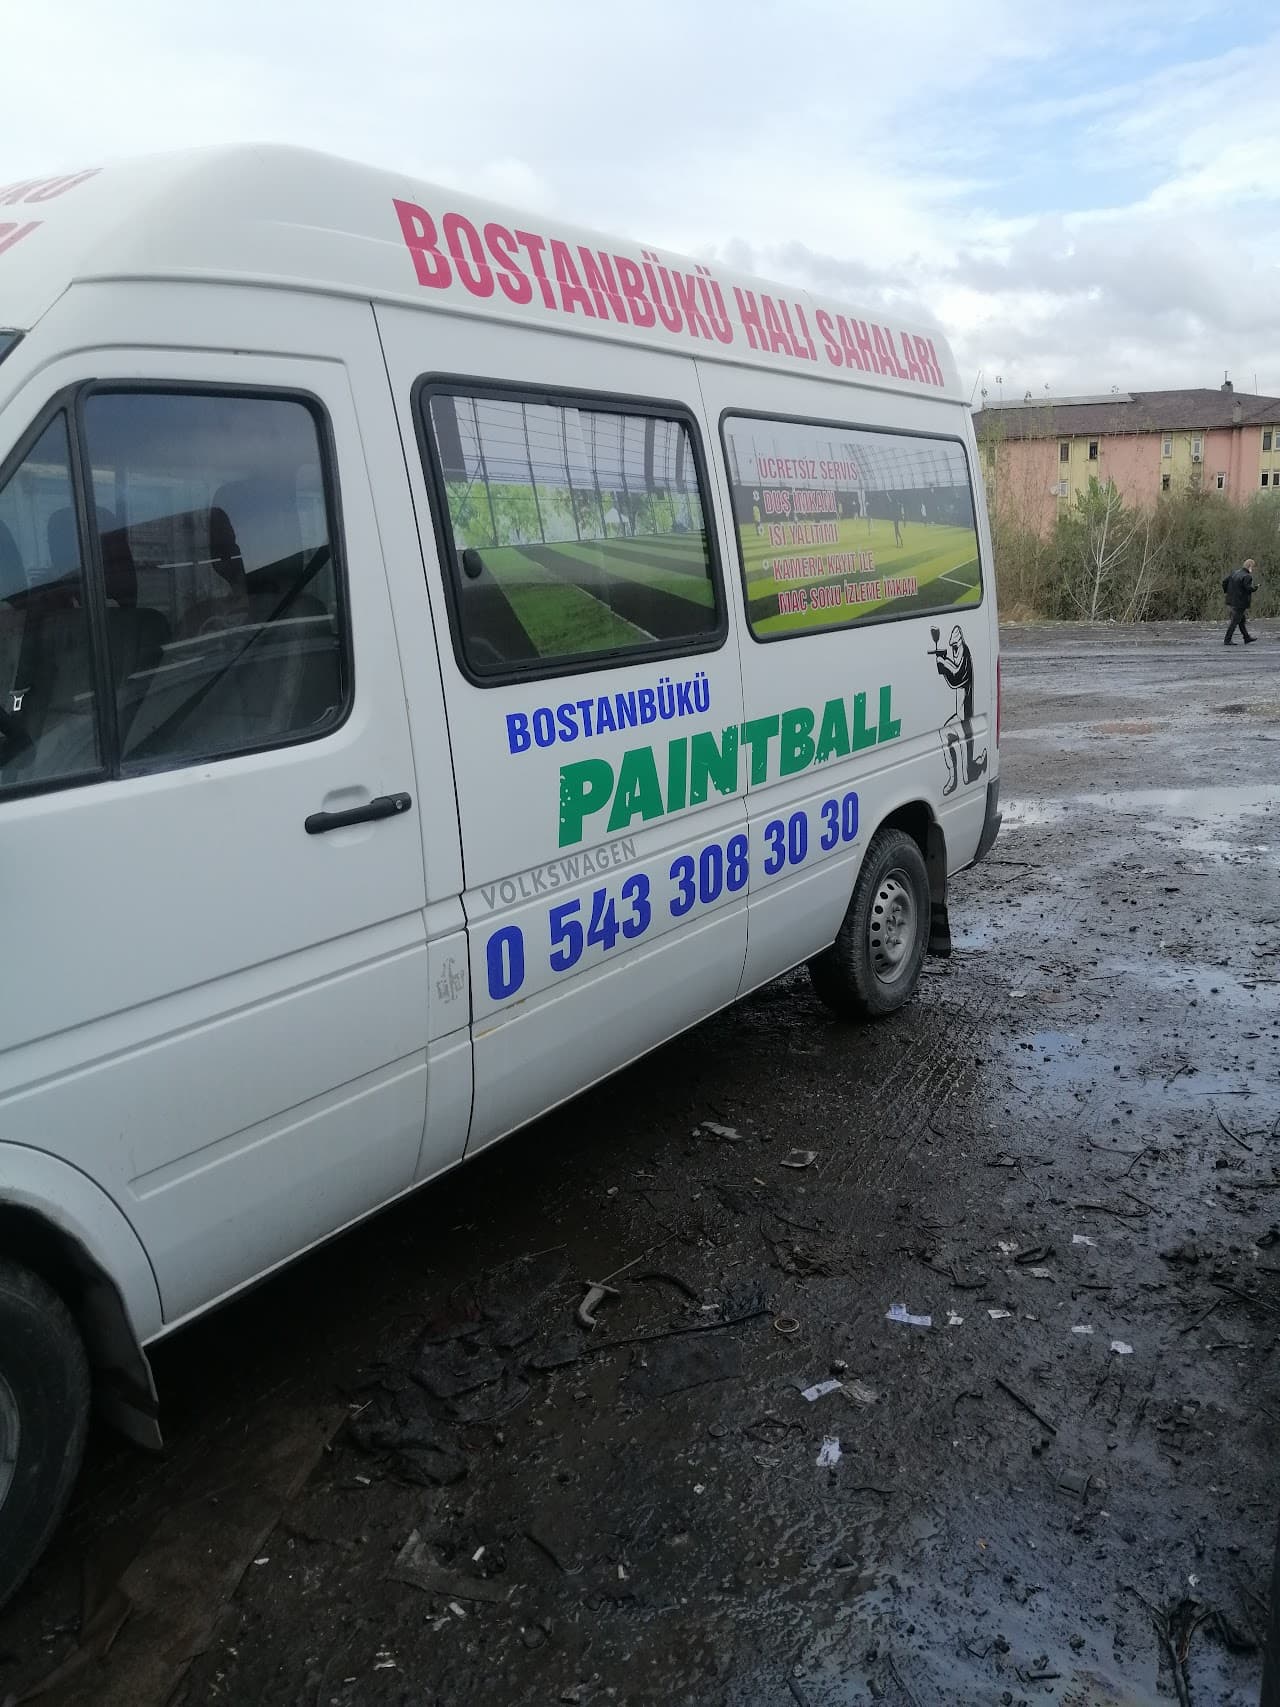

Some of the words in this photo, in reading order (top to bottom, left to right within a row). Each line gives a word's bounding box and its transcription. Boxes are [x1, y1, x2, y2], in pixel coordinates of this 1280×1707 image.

[392, 199, 733, 344] BOSTANBÜKÜ
[733, 287, 818, 361] HALI
[816, 309, 945, 387] SAHALARI
[773, 557, 824, 581] KAMERA
[778, 589, 807, 614] MAÇ
[506, 672, 710, 754] BOSTANBÜKÜ
[558, 685, 902, 848] PAINTBALL
[481, 839, 638, 910] VOLKSWAGEN
[549, 873, 651, 972] 543
[669, 834, 750, 917] 308
[764, 811, 808, 876] 30
[820, 791, 859, 851] 30
